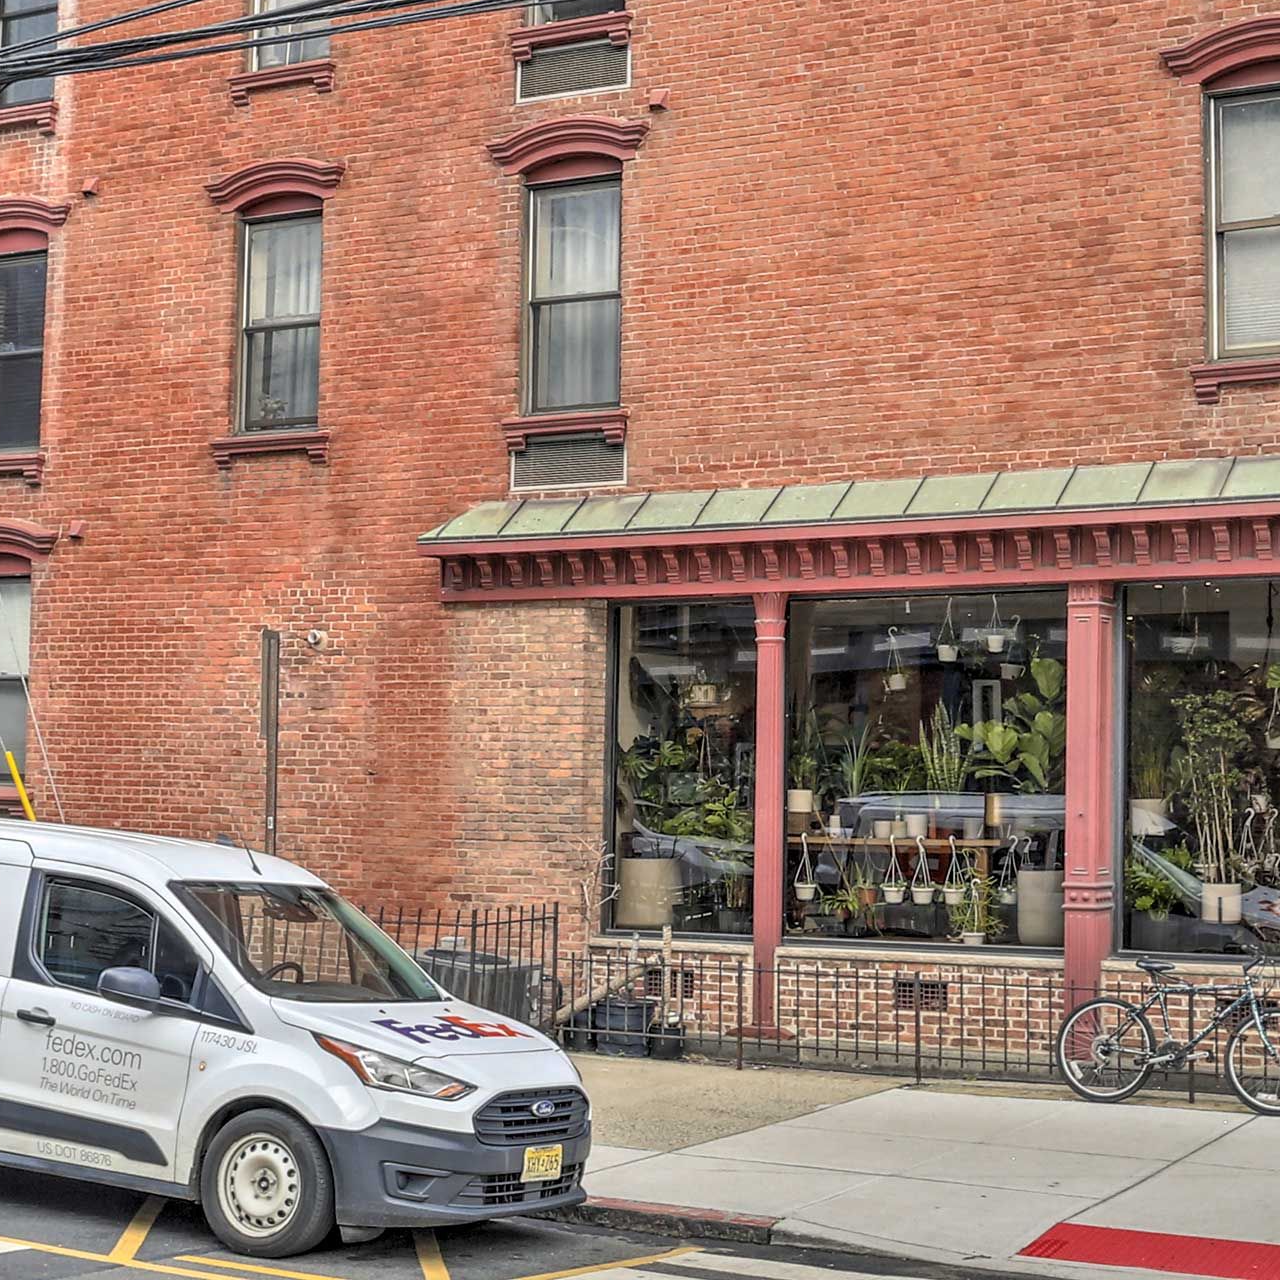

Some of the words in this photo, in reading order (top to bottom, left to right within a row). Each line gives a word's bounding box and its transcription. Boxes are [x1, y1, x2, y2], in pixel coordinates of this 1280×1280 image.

[200, 1030, 237, 1050] 117430
[370, 1015, 535, 1045] FedEx
[45, 1029, 142, 1070] fedex.com
[42, 1056, 138, 1092] 1.800.GoFedEx
[39, 1077, 58, 1094] The
[58, 1080, 90, 1101] World
[92, 1087, 109, 1104] On
[109, 1091, 137, 1110] Time
[36, 1140, 54, 1155] US
[54, 1143, 79, 1160] DOT
[80, 1148, 112, 1167] 86876
